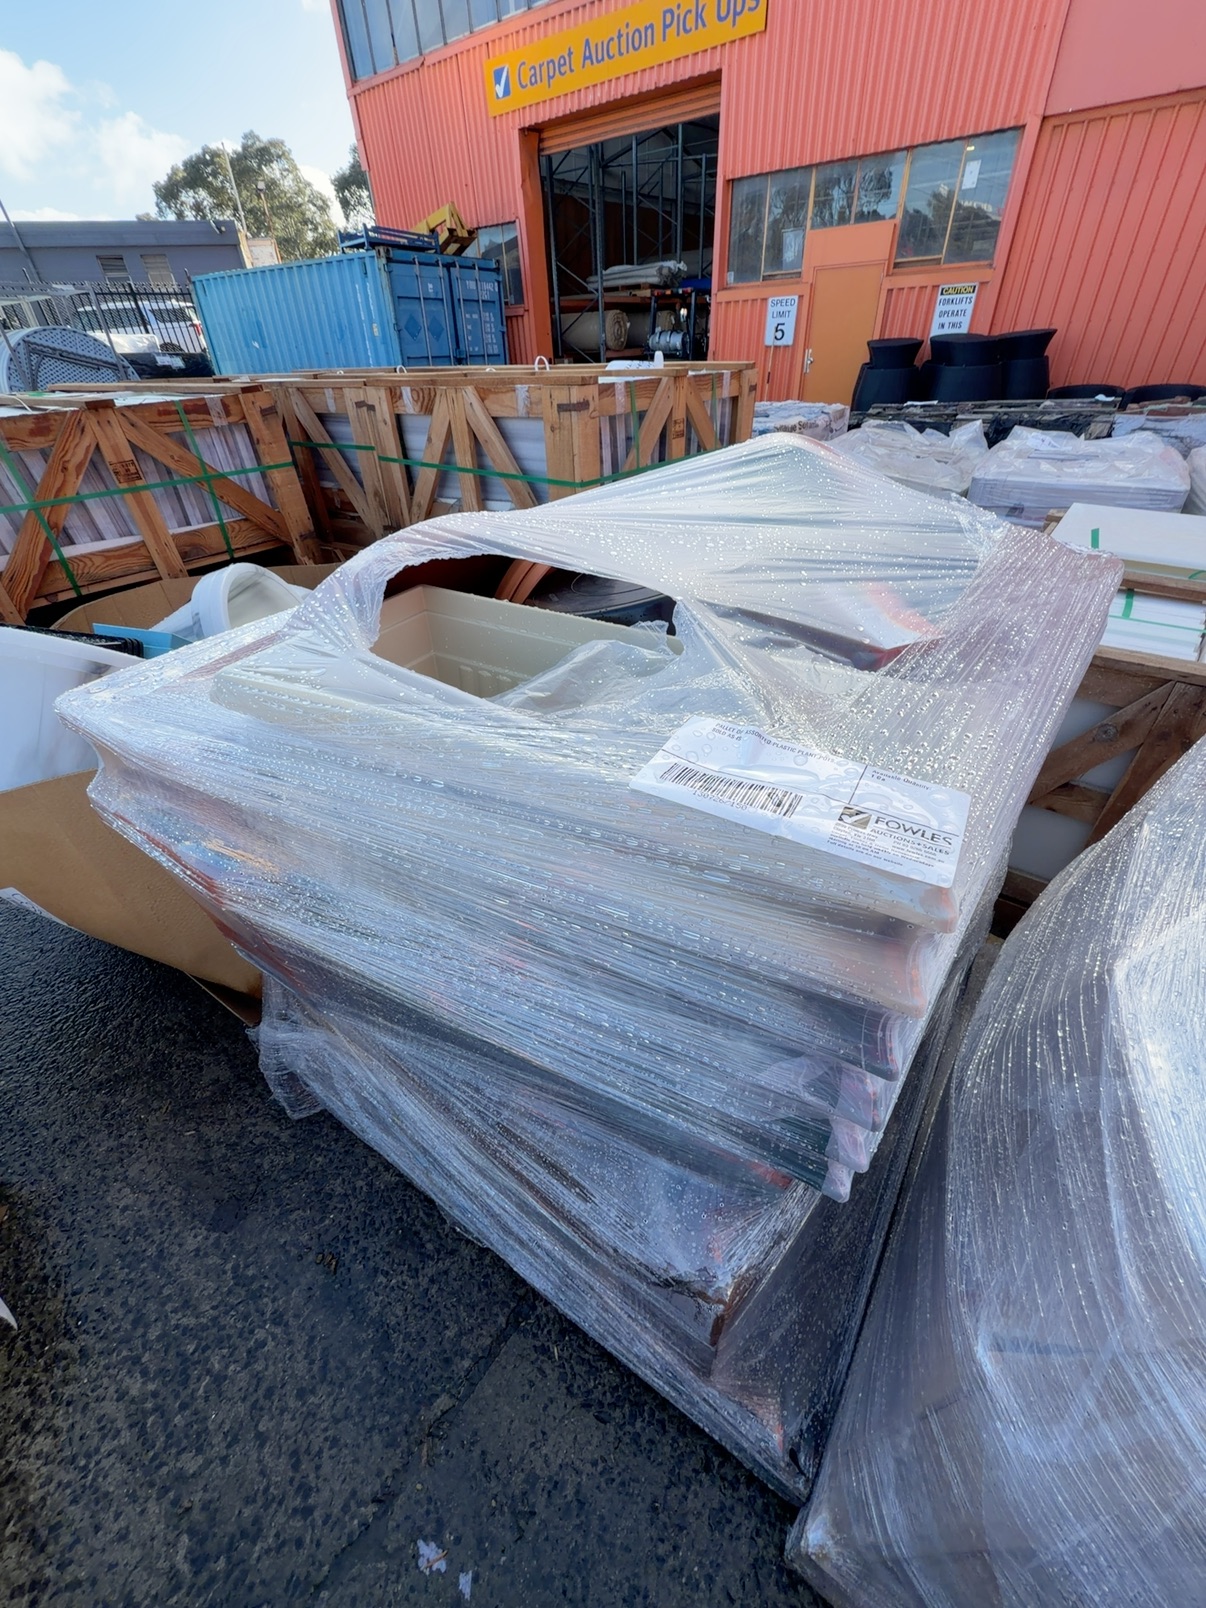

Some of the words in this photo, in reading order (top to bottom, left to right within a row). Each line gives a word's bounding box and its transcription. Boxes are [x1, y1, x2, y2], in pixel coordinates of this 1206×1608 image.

[517, 48, 575, 90] Carpet
[581, 21, 655, 69] Auction
[661, 0, 707, 42] Pick
[942, 285, 974, 295] CAUTION
[770, 298, 796, 307] SPEED
[938, 296, 973, 306] FORKLIFTS
[771, 310, 791, 319] LIMIT
[938, 309, 967, 318] OPERATE
[938, 322, 946, 330] IN
[948, 321, 963, 329] THIS
[774, 322, 786, 341] 5
[715, 723, 735, 733] PALLET
[772, 742, 797, 753] PLASTIC
[797, 749, 817, 759] PLANT
[874, 815, 953, 846] FOWLES
